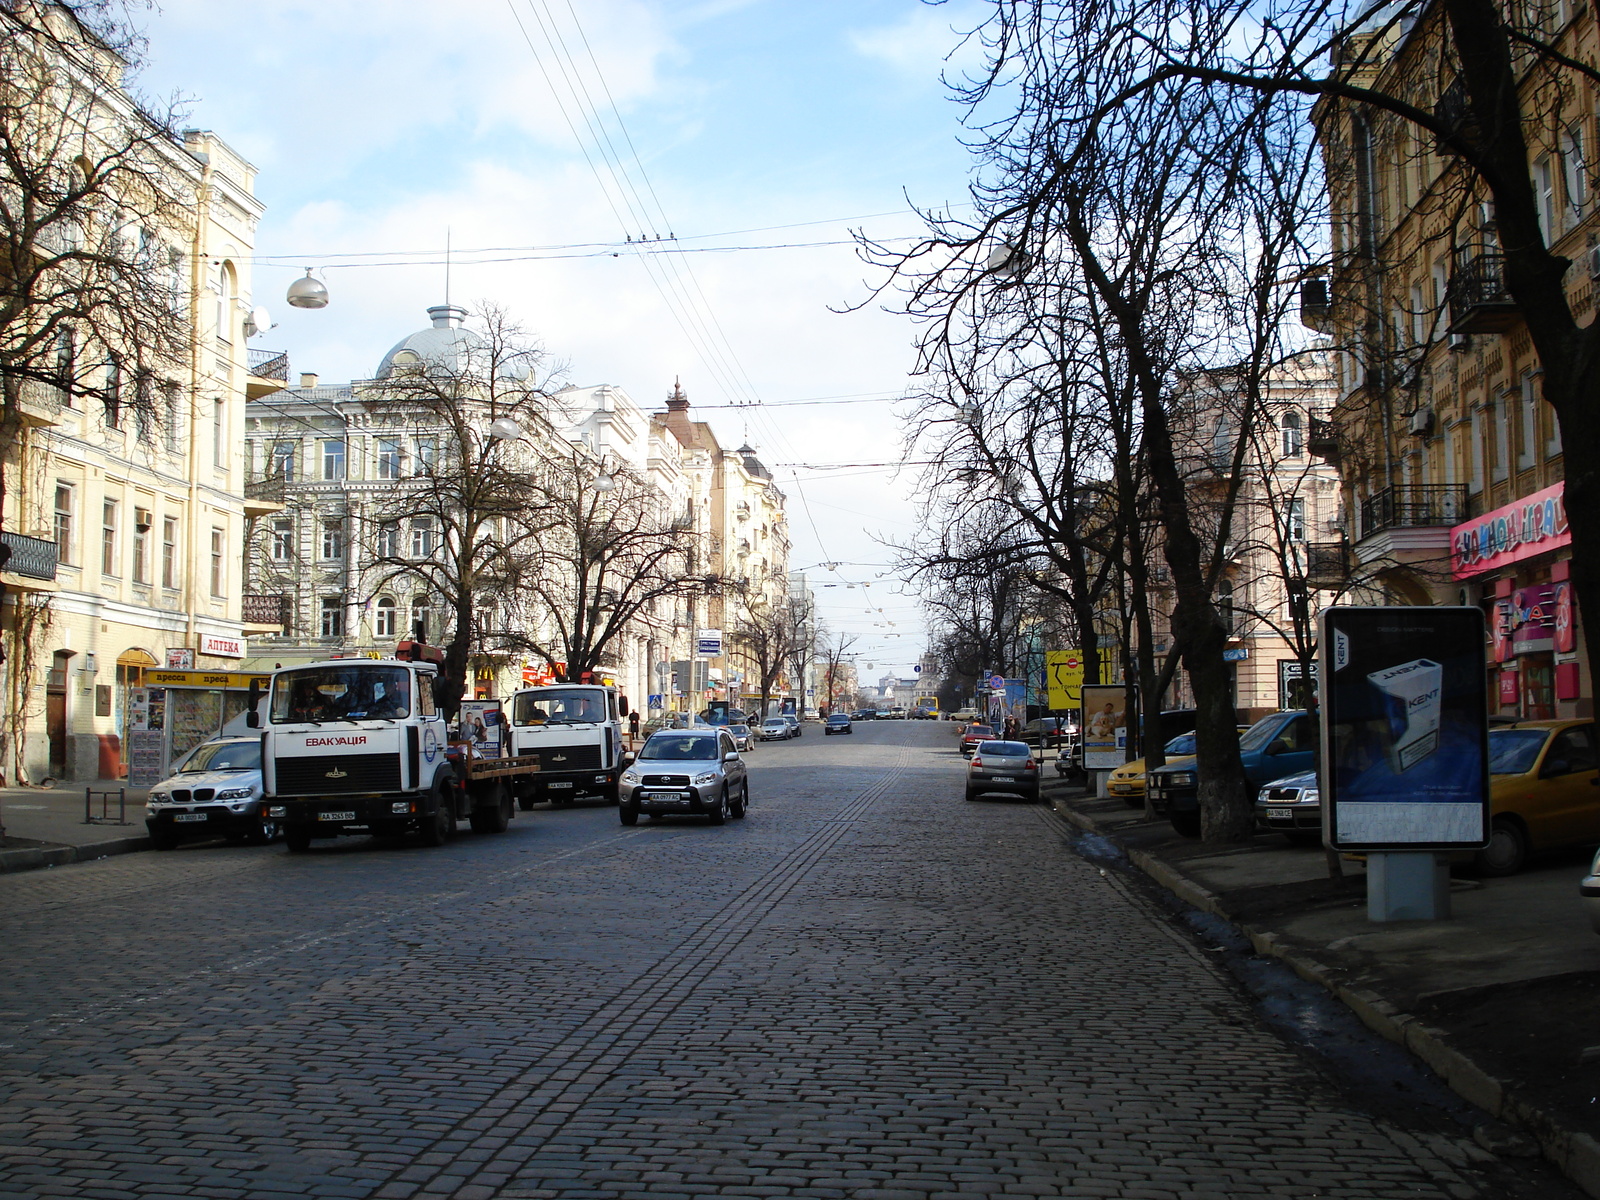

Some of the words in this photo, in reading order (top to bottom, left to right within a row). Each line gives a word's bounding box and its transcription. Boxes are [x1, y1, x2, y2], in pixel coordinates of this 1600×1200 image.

[207, 639, 240, 653] АПТЕКА
[1337, 635, 1345, 665] KENT
[156, 673, 186, 682] пресса
[1383, 664, 1421, 680] KENT
[204, 675, 229, 684] преса
[1408, 688, 1439, 708] KENT
[306, 736, 367, 747] ЕВАКУАЦІЯ
